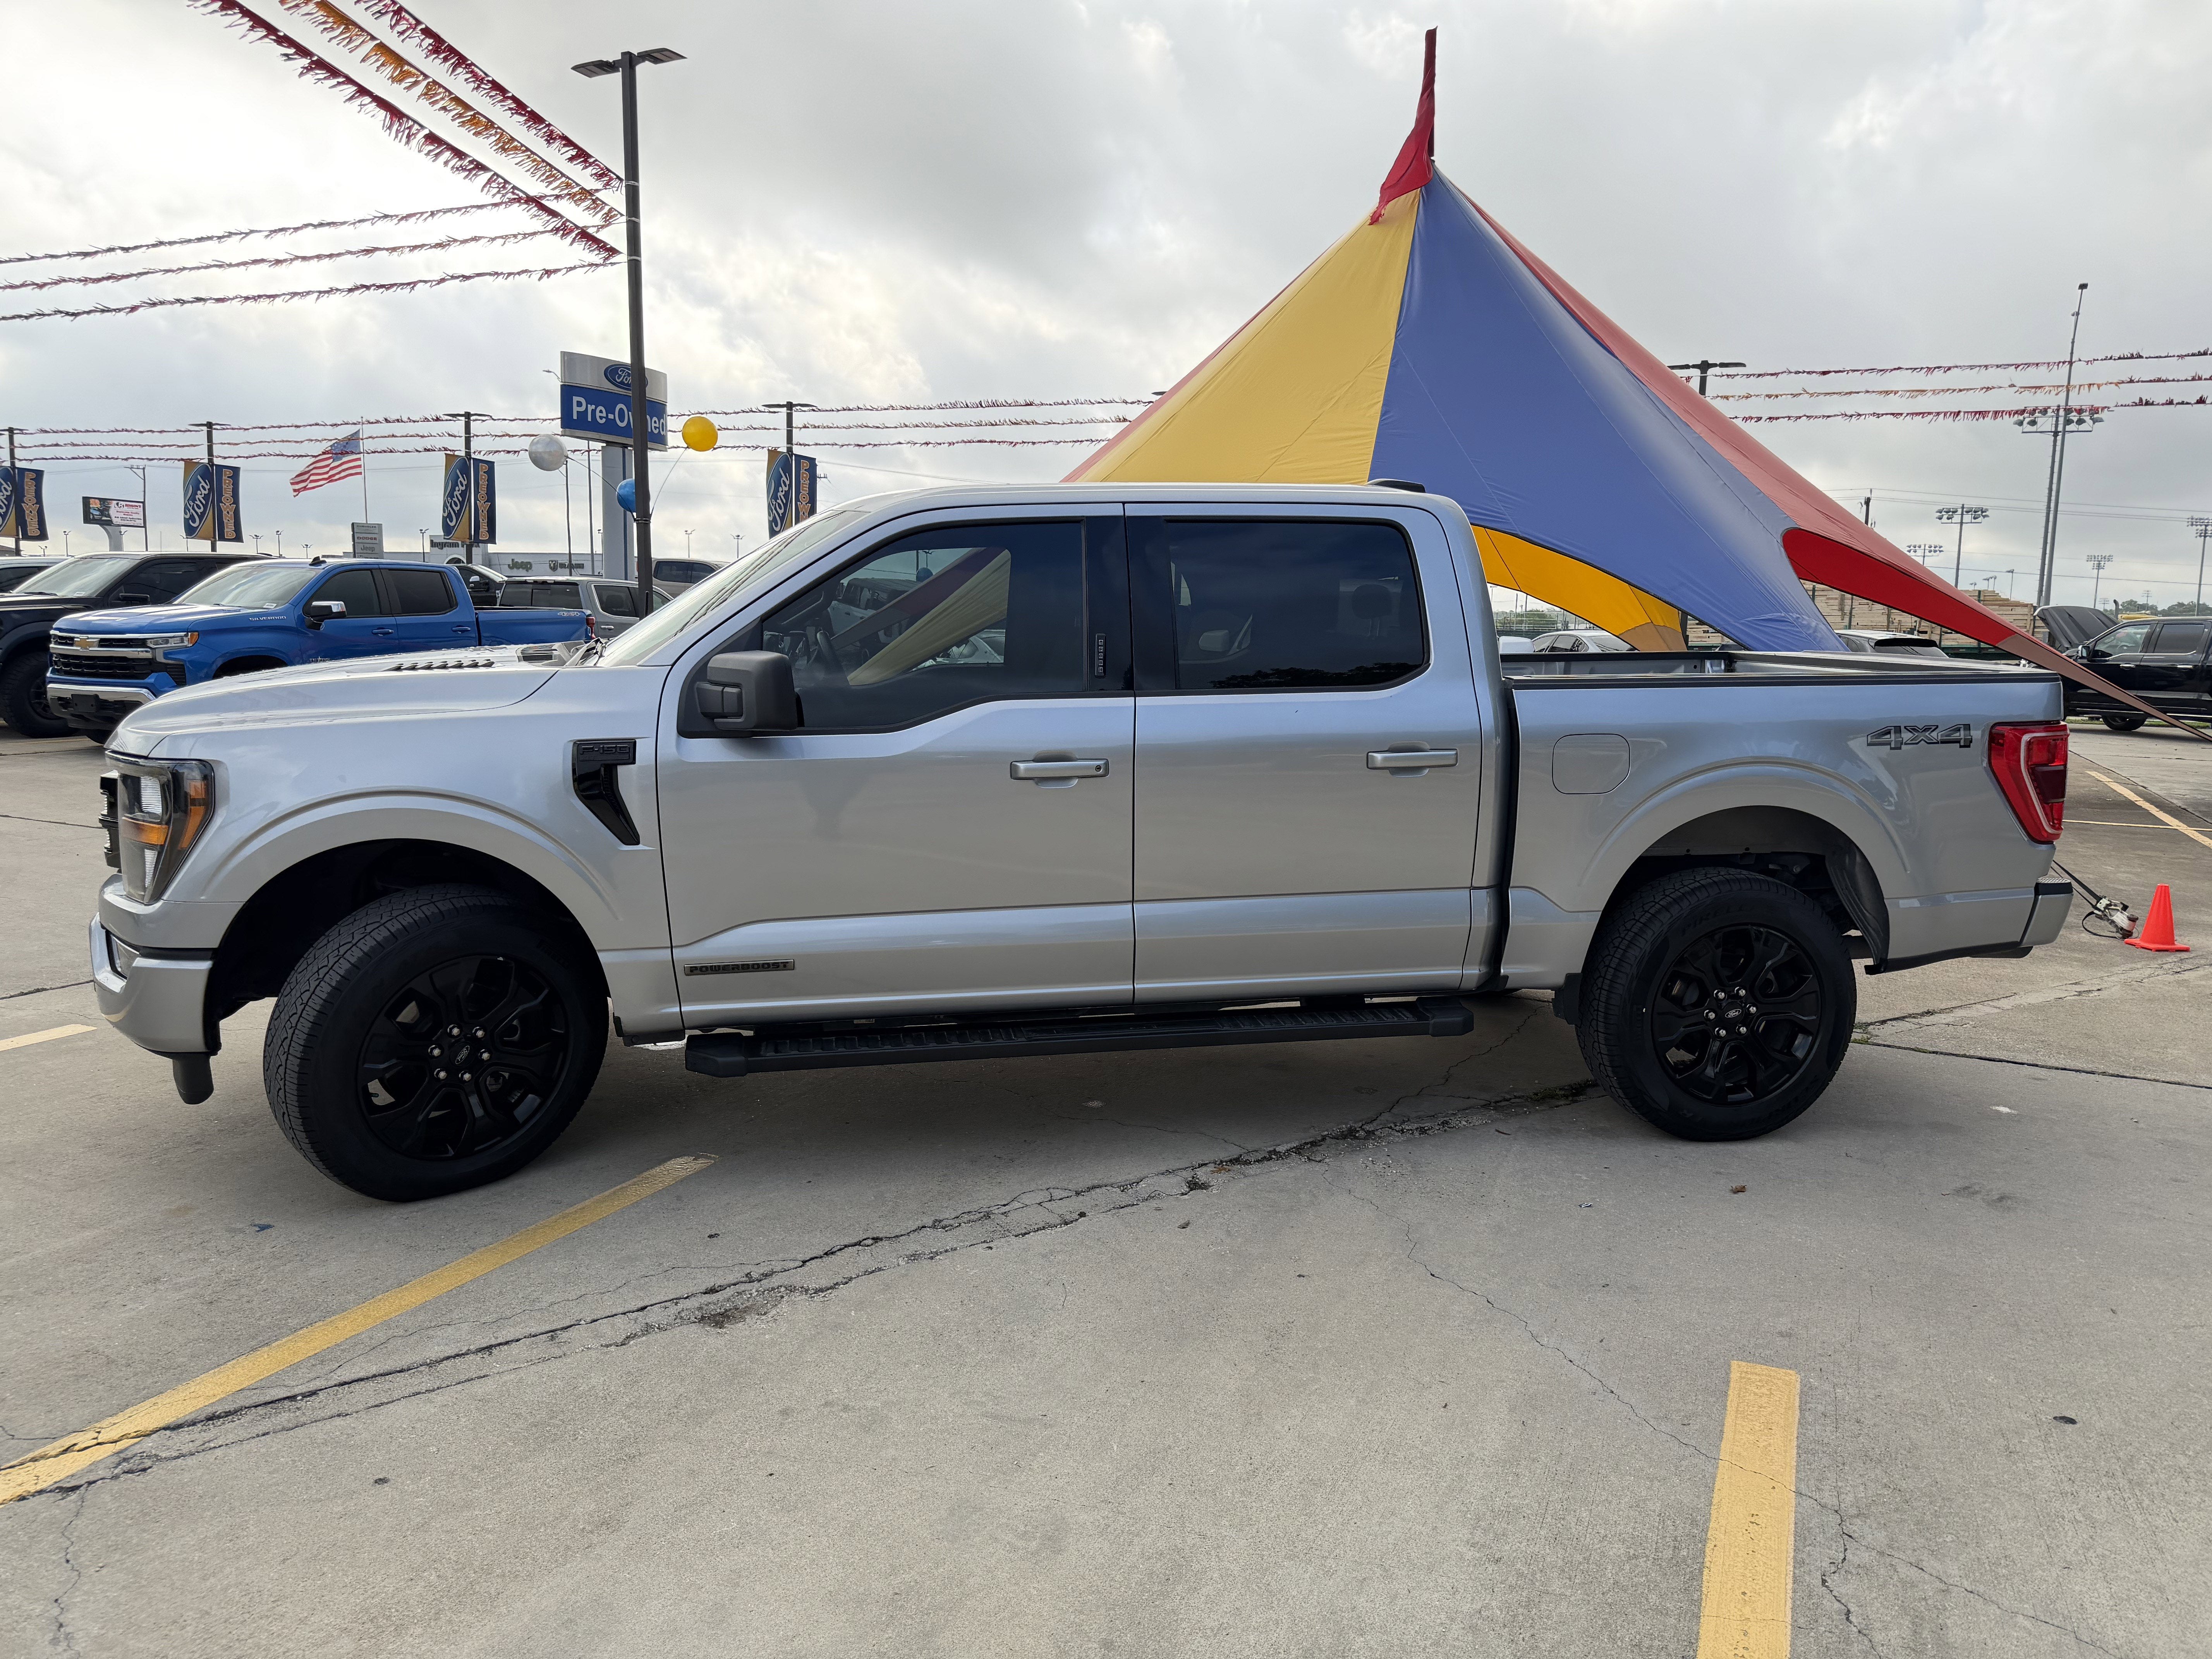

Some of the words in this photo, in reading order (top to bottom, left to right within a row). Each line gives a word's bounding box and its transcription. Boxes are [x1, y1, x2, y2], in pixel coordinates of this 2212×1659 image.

[616, 368, 632, 384] Fo
[573, 396, 666, 436] Pre-Oned
[0, 477, 12, 526] ord
[21, 472, 40, 536] PREOWNED
[184, 475, 210, 527] Ford
[220, 469, 236, 539] PREOWNED
[443, 469, 467, 526] Ford
[477, 463, 491, 540] PREOWNED
[768, 467, 790, 531] Ford
[798, 460, 811, 523] PREOWN
[430, 539, 459, 550] Ingram
[508, 558, 533, 572] Jeep
[580, 744, 630, 755] F-150
[690, 961, 789, 974] POWERBOOST
